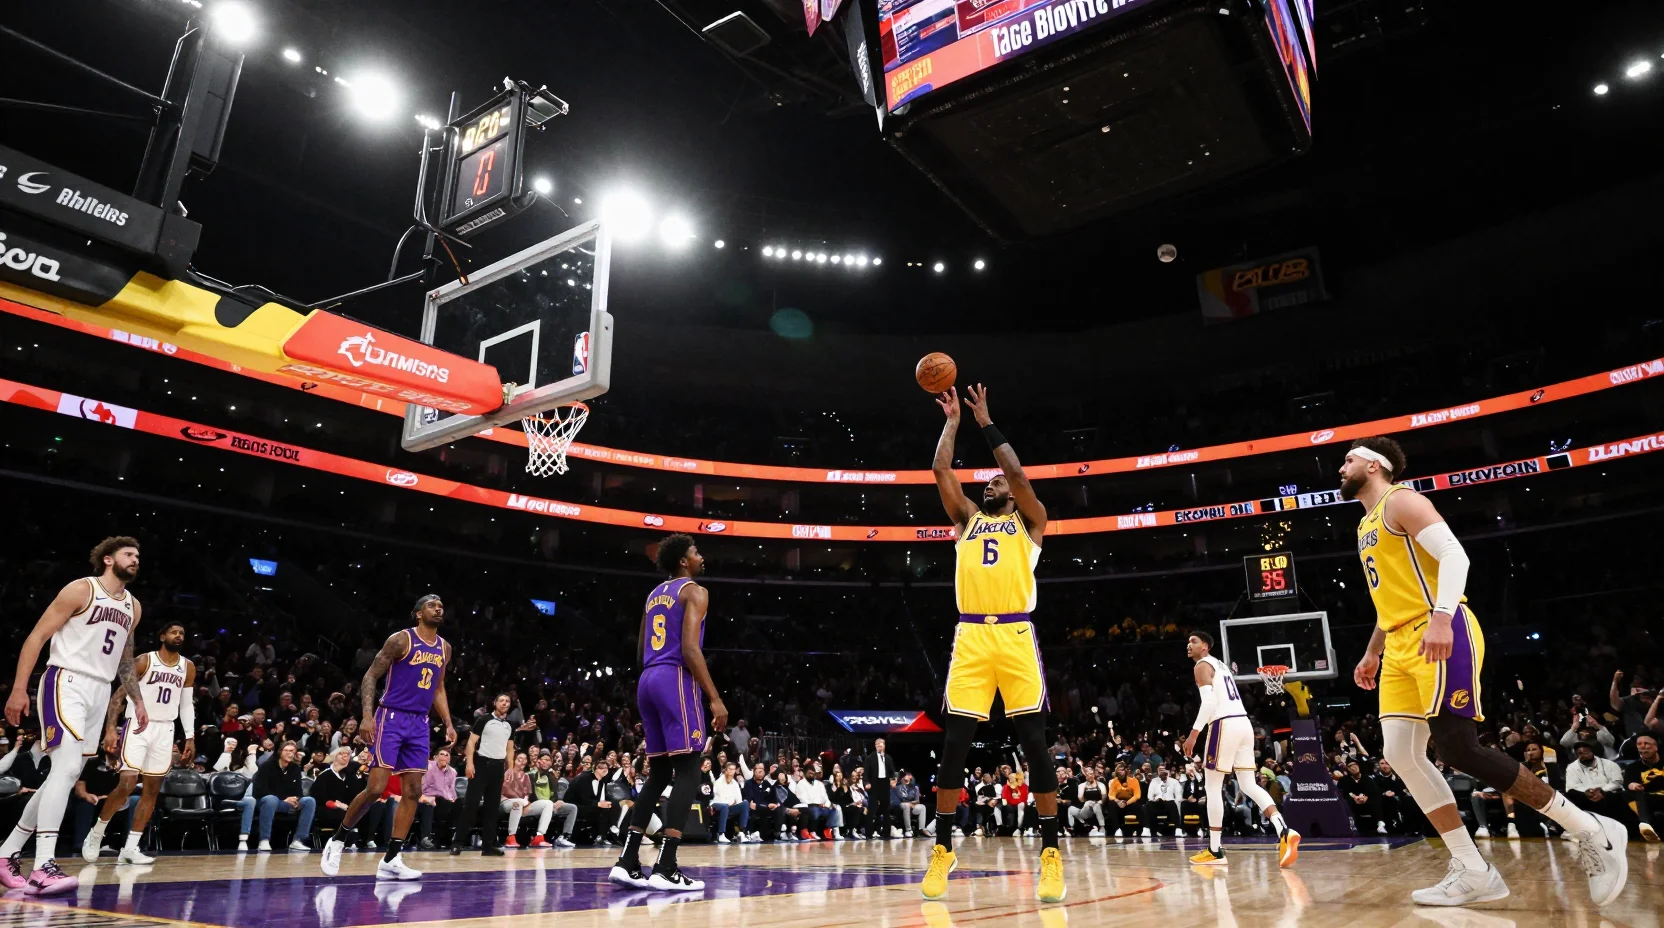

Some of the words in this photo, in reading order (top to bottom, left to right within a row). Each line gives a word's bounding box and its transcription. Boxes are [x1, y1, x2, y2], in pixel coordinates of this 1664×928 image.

[982, 538, 999, 566] 6
[102, 628, 117, 655] 5
[156, 685, 172, 704] 10
